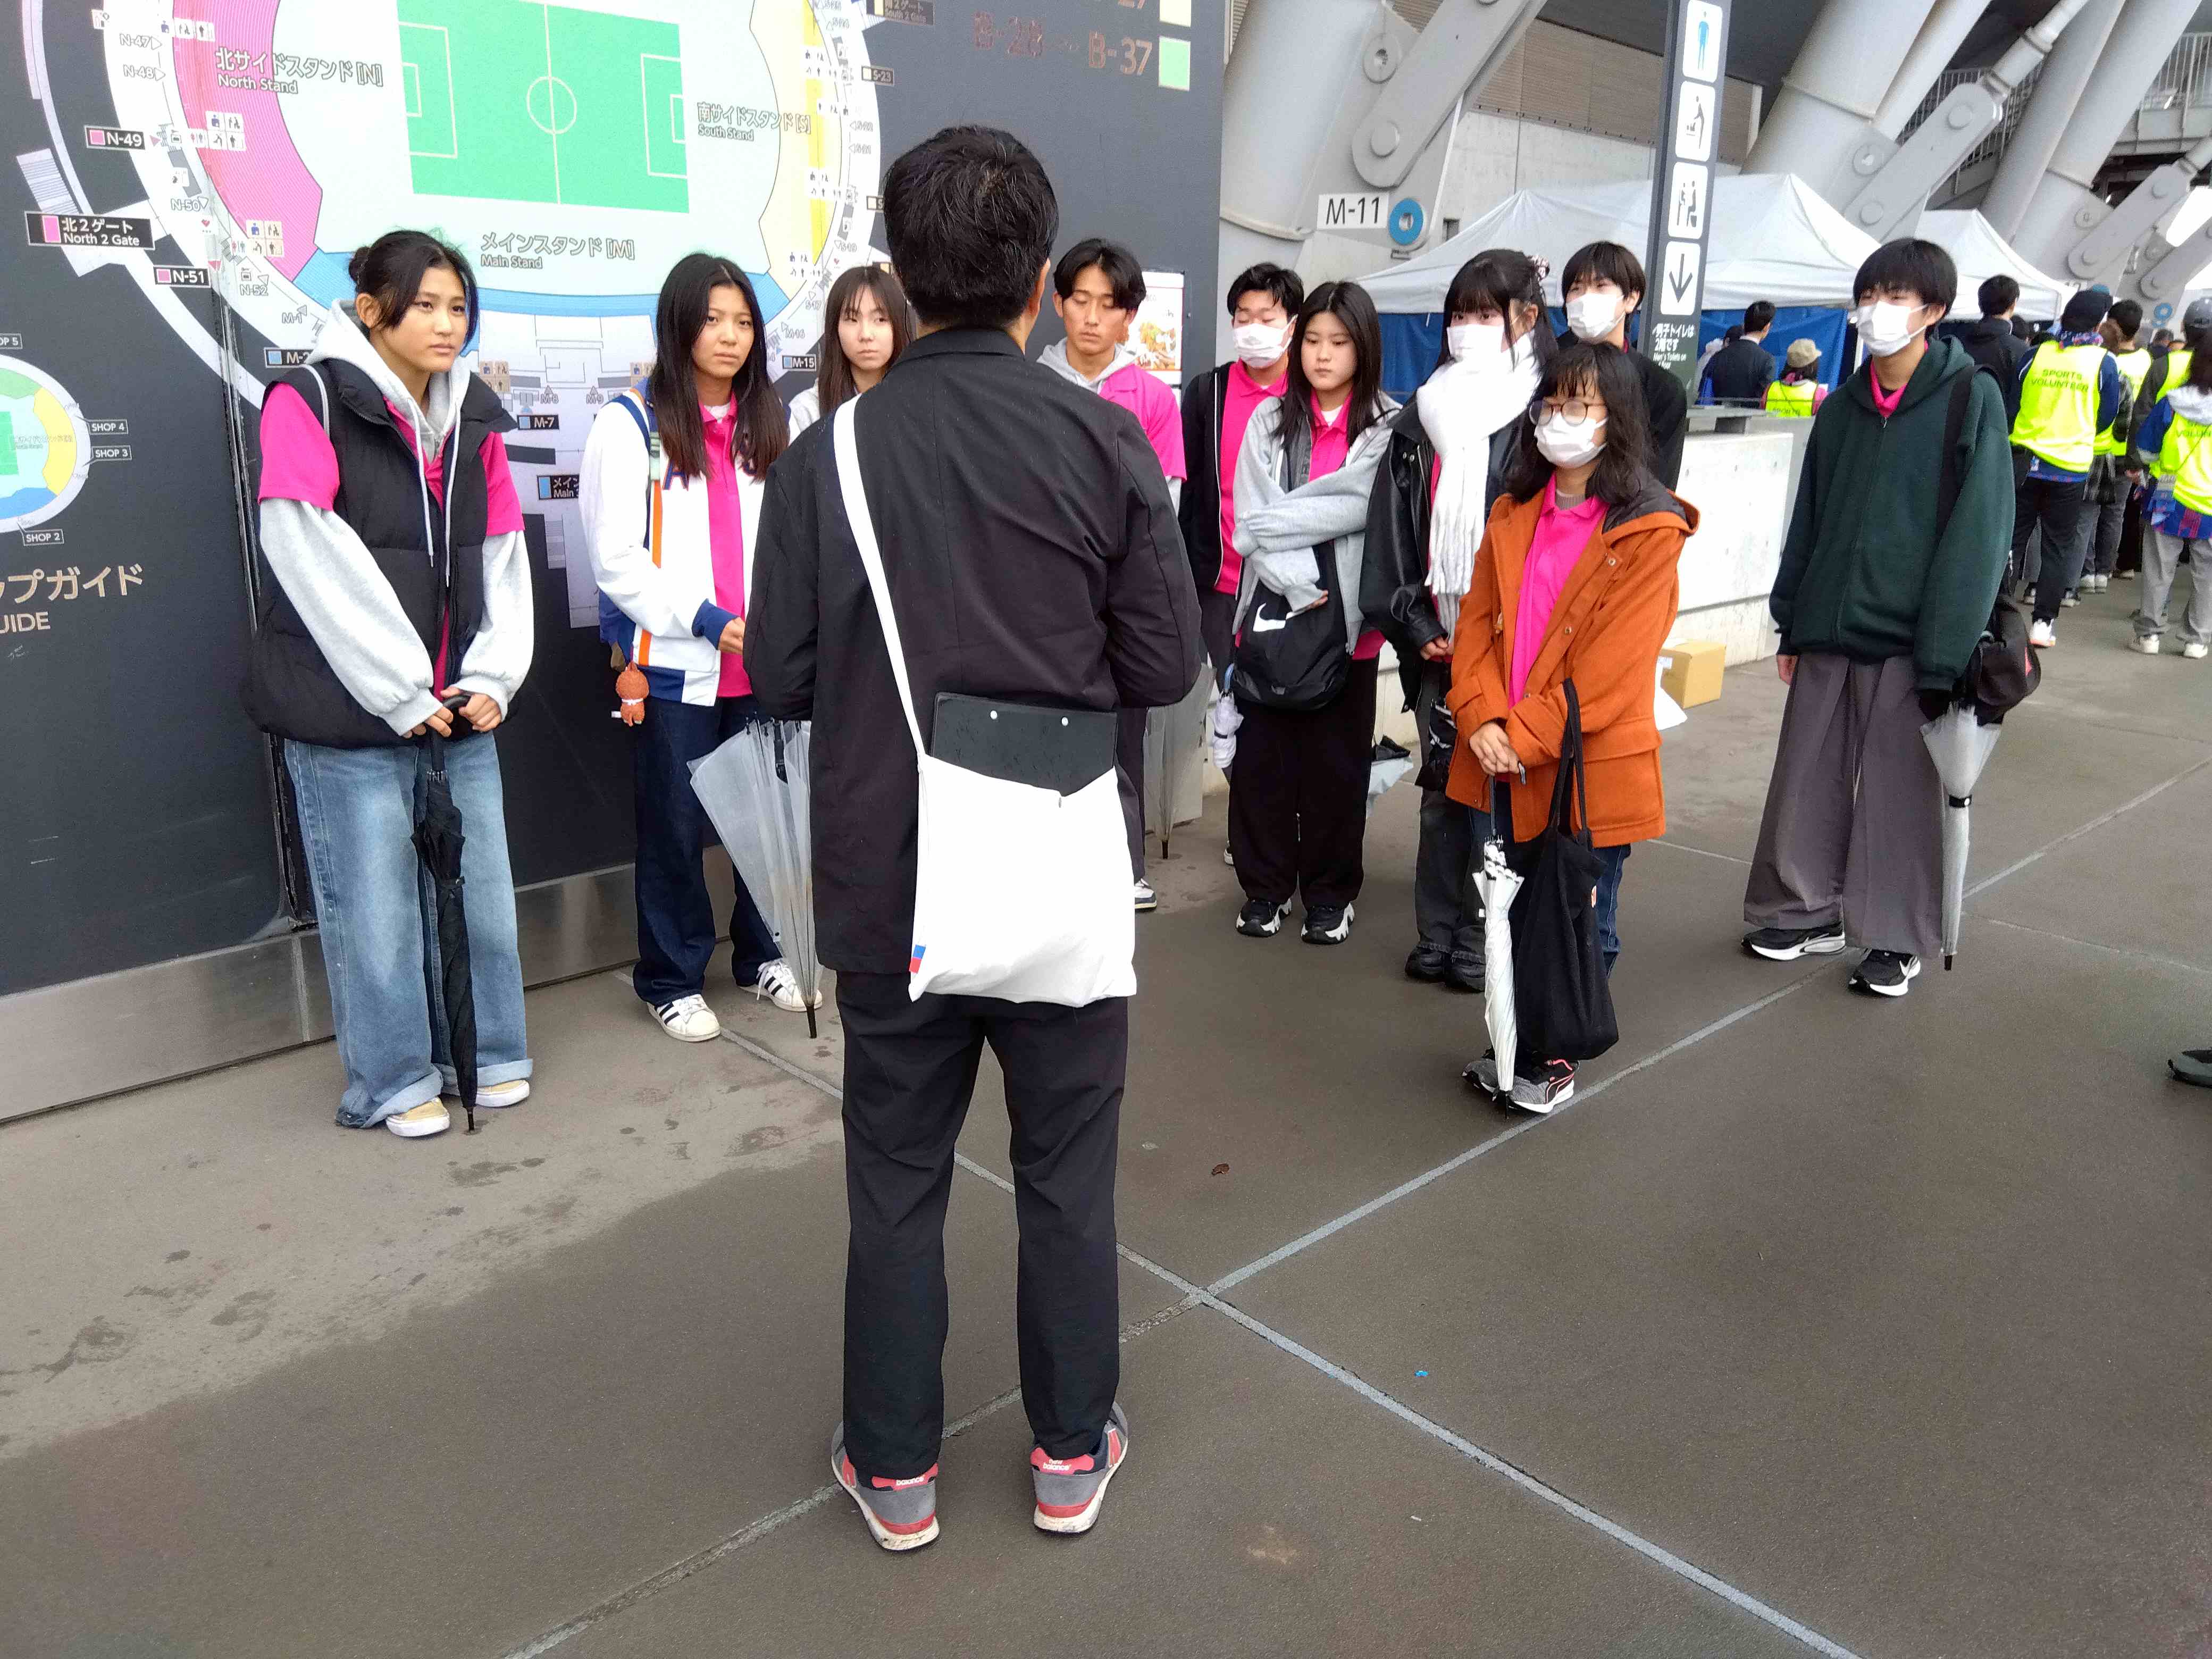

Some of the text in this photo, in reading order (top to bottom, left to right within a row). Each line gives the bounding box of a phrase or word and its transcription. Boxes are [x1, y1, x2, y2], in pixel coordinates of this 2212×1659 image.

[119, 33, 149, 48] N-47
[1088, 33, 1153, 76] B-37
[123, 64, 155, 79] N-48
[215, 47, 383, 87] 北サイドスタンド [N]
[873, 71, 892, 82] S-23
[217, 73, 298, 95] North Stand
[697, 101, 793, 131] 南サイドスタンド
[698, 123, 754, 142] South Stand
[106, 132, 142, 147] N-49
[170, 198, 200, 212] N-50
[1326, 196, 1380, 225] M-11
[63, 234, 140, 246] North 2 Gate
[481, 232, 635, 261] メインスタンド [M]
[481, 254, 543, 270] Main Stand
[172, 270, 205, 283] N-51
[239, 284, 269, 297] N-52
[281, 312, 303, 324] M-1
[12, 337, 19, 346] 5
[792, 355, 815, 368] M-15
[2042, 368, 2083, 381] SPORTS
[2031, 378, 2089, 392] VOLUNTEER
[585, 393, 605, 405] M-9
[534, 416, 555, 429] M-7
[553, 488, 574, 498] Main
[26, 532, 61, 543] SHOP 2
[1043, 1462, 1070, 1471] balance
[896, 1474, 924, 1486] balance
